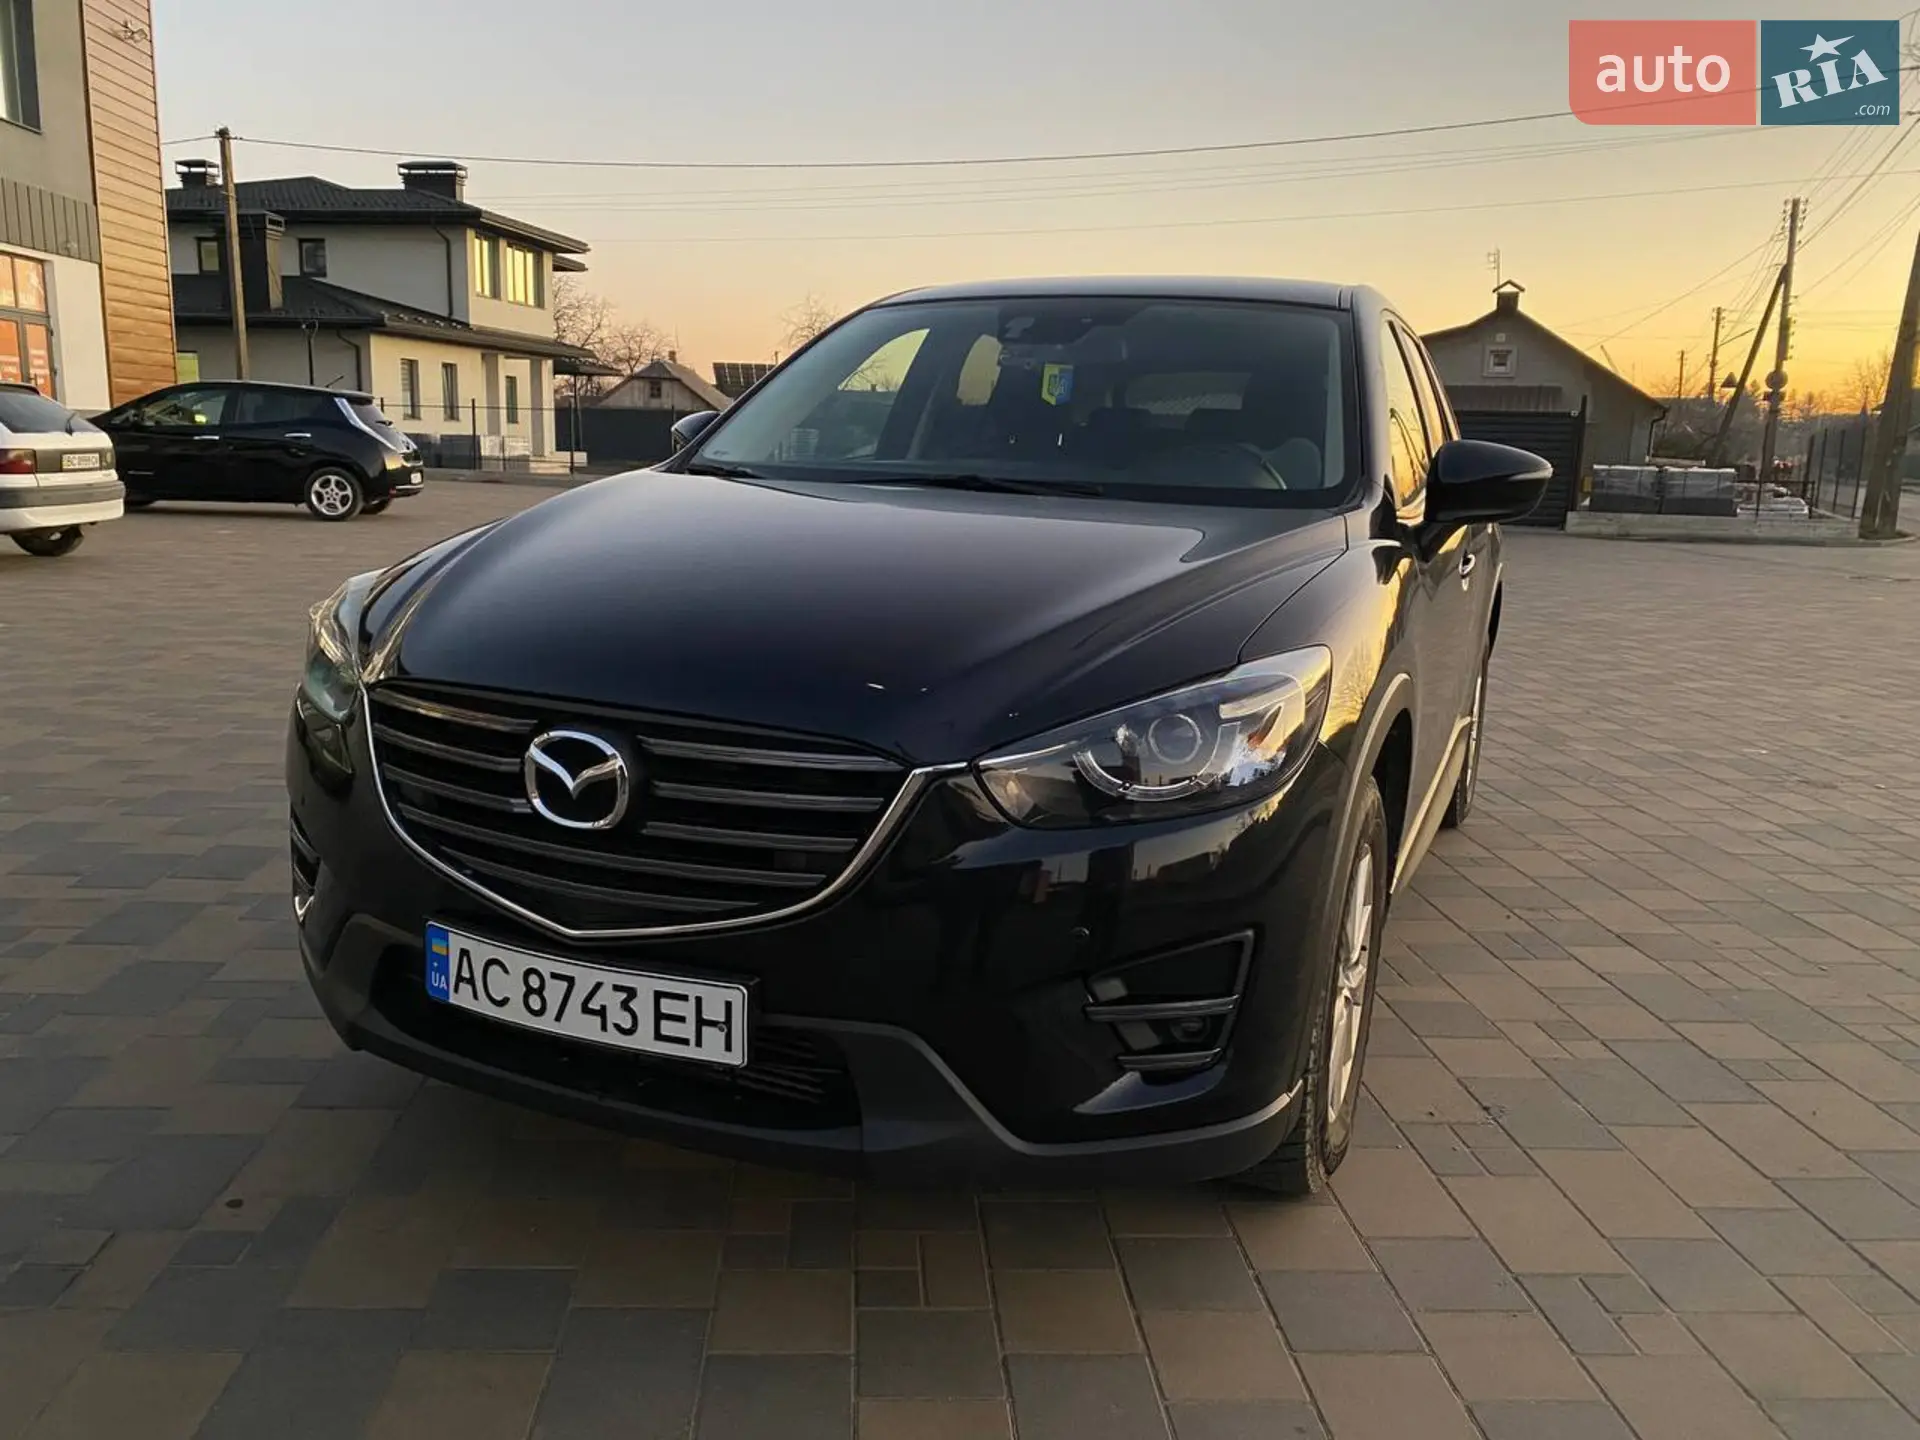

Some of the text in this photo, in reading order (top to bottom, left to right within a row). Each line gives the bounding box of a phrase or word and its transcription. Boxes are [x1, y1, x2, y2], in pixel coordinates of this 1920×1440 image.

[431, 971, 448, 991] UA
[453, 948, 733, 1053] AC 8743 EH
